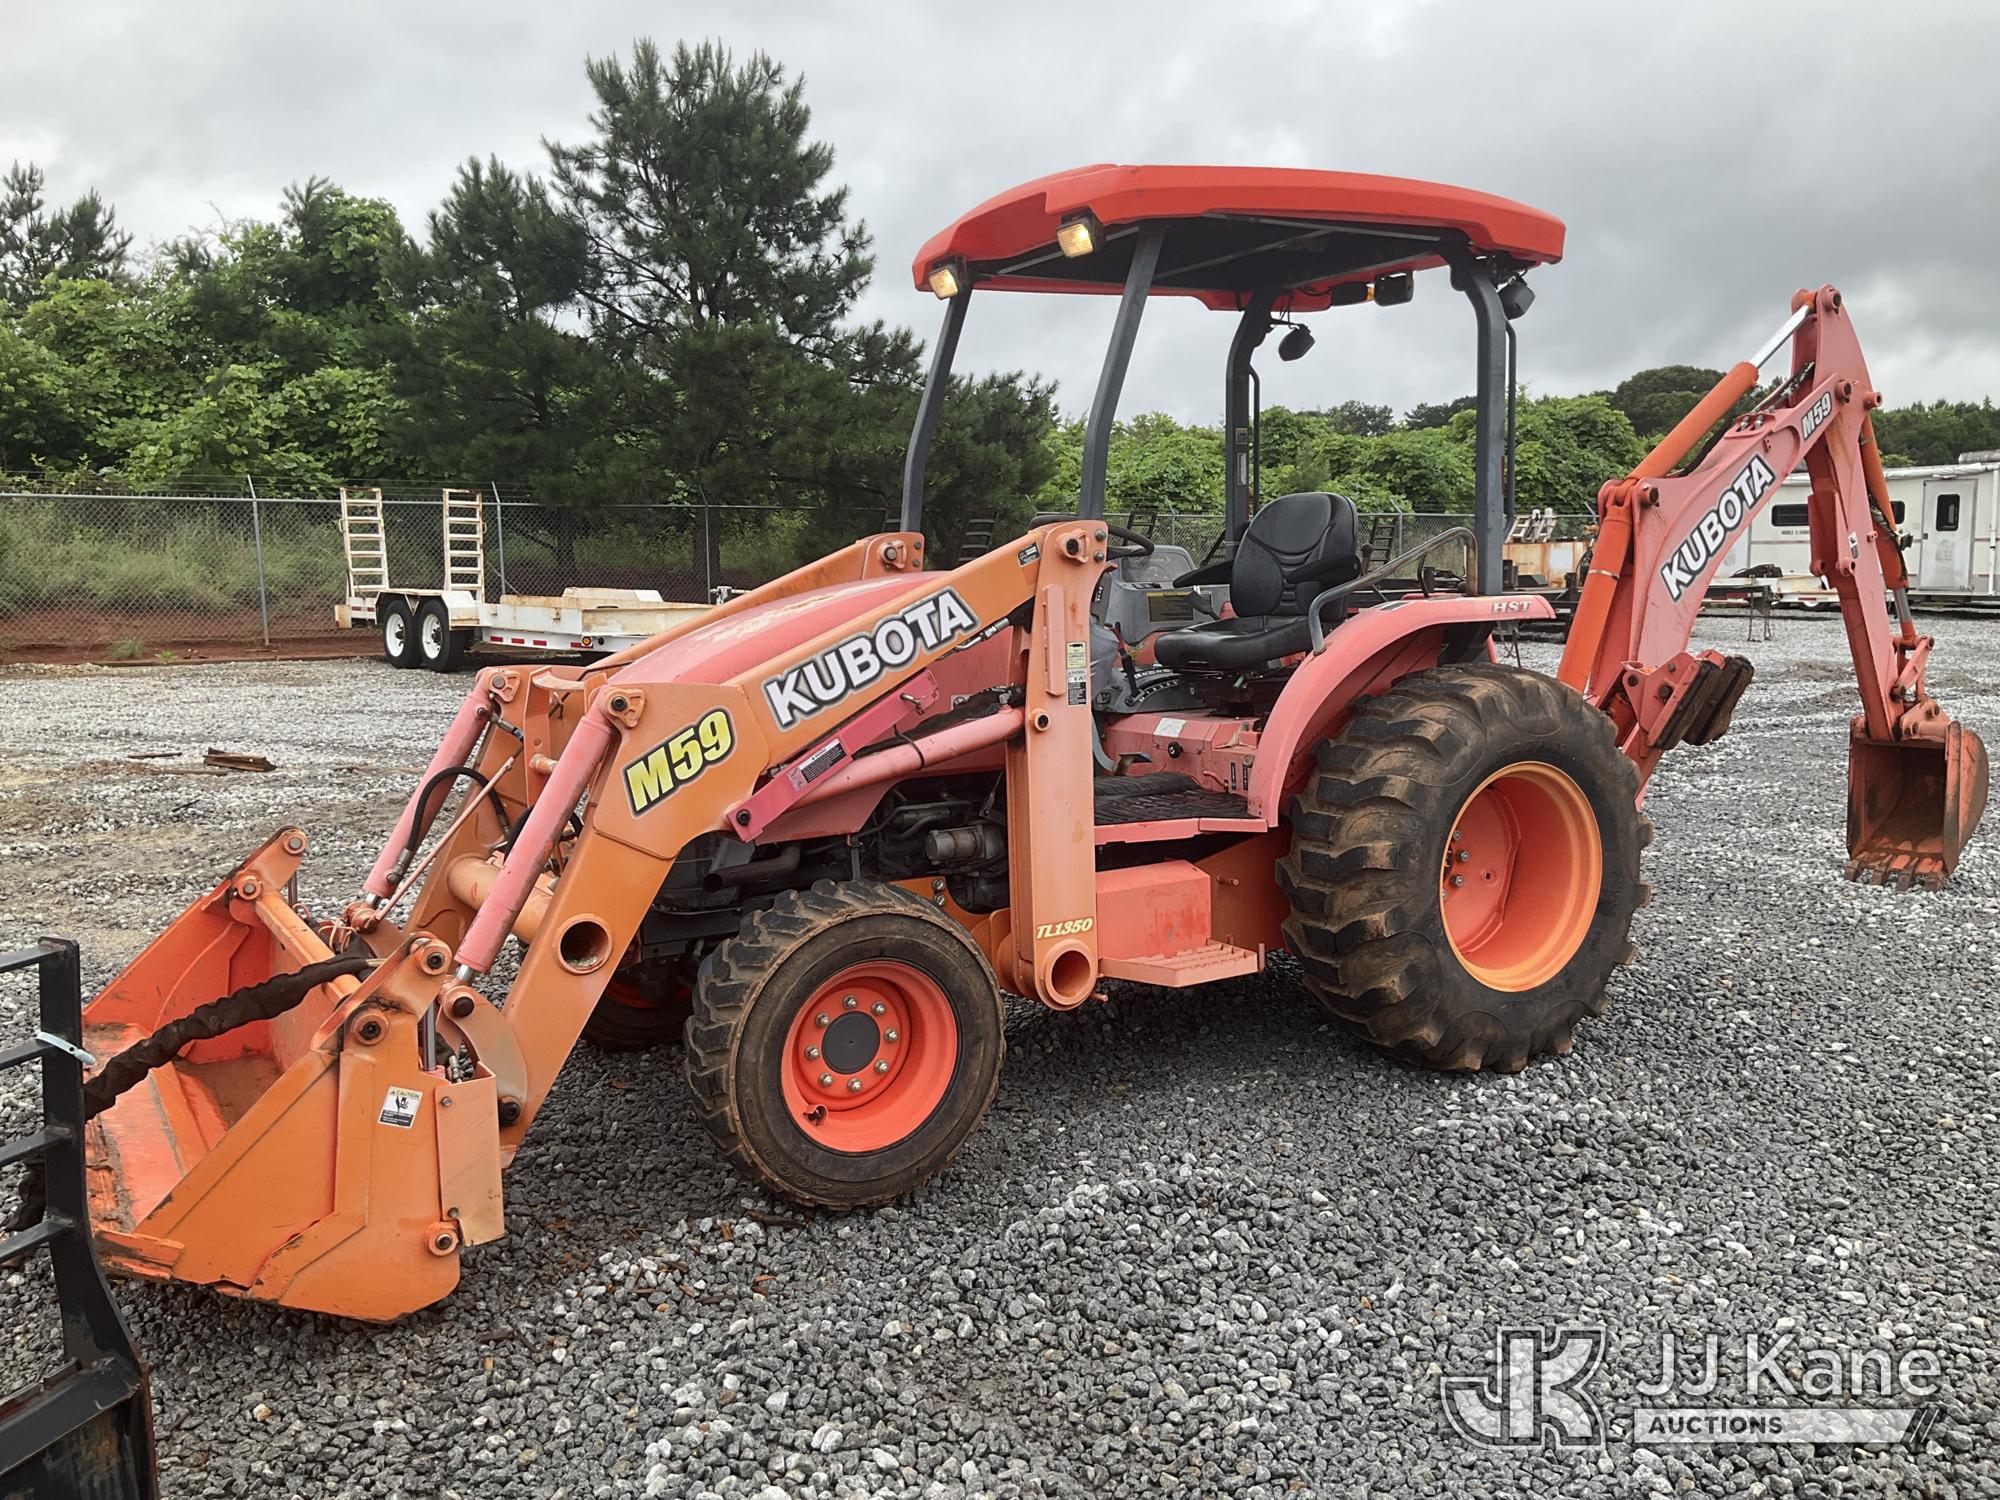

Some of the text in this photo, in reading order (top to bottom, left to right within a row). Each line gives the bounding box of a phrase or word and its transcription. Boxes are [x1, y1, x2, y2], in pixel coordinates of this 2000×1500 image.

[1801, 392, 1831, 439] M59
[1661, 456, 1774, 600] KUBOTA
[1491, 600, 1531, 614] HST
[764, 589, 976, 727] KUBOTA
[625, 709, 733, 813] M59
[1036, 917, 1093, 939] TL1350
